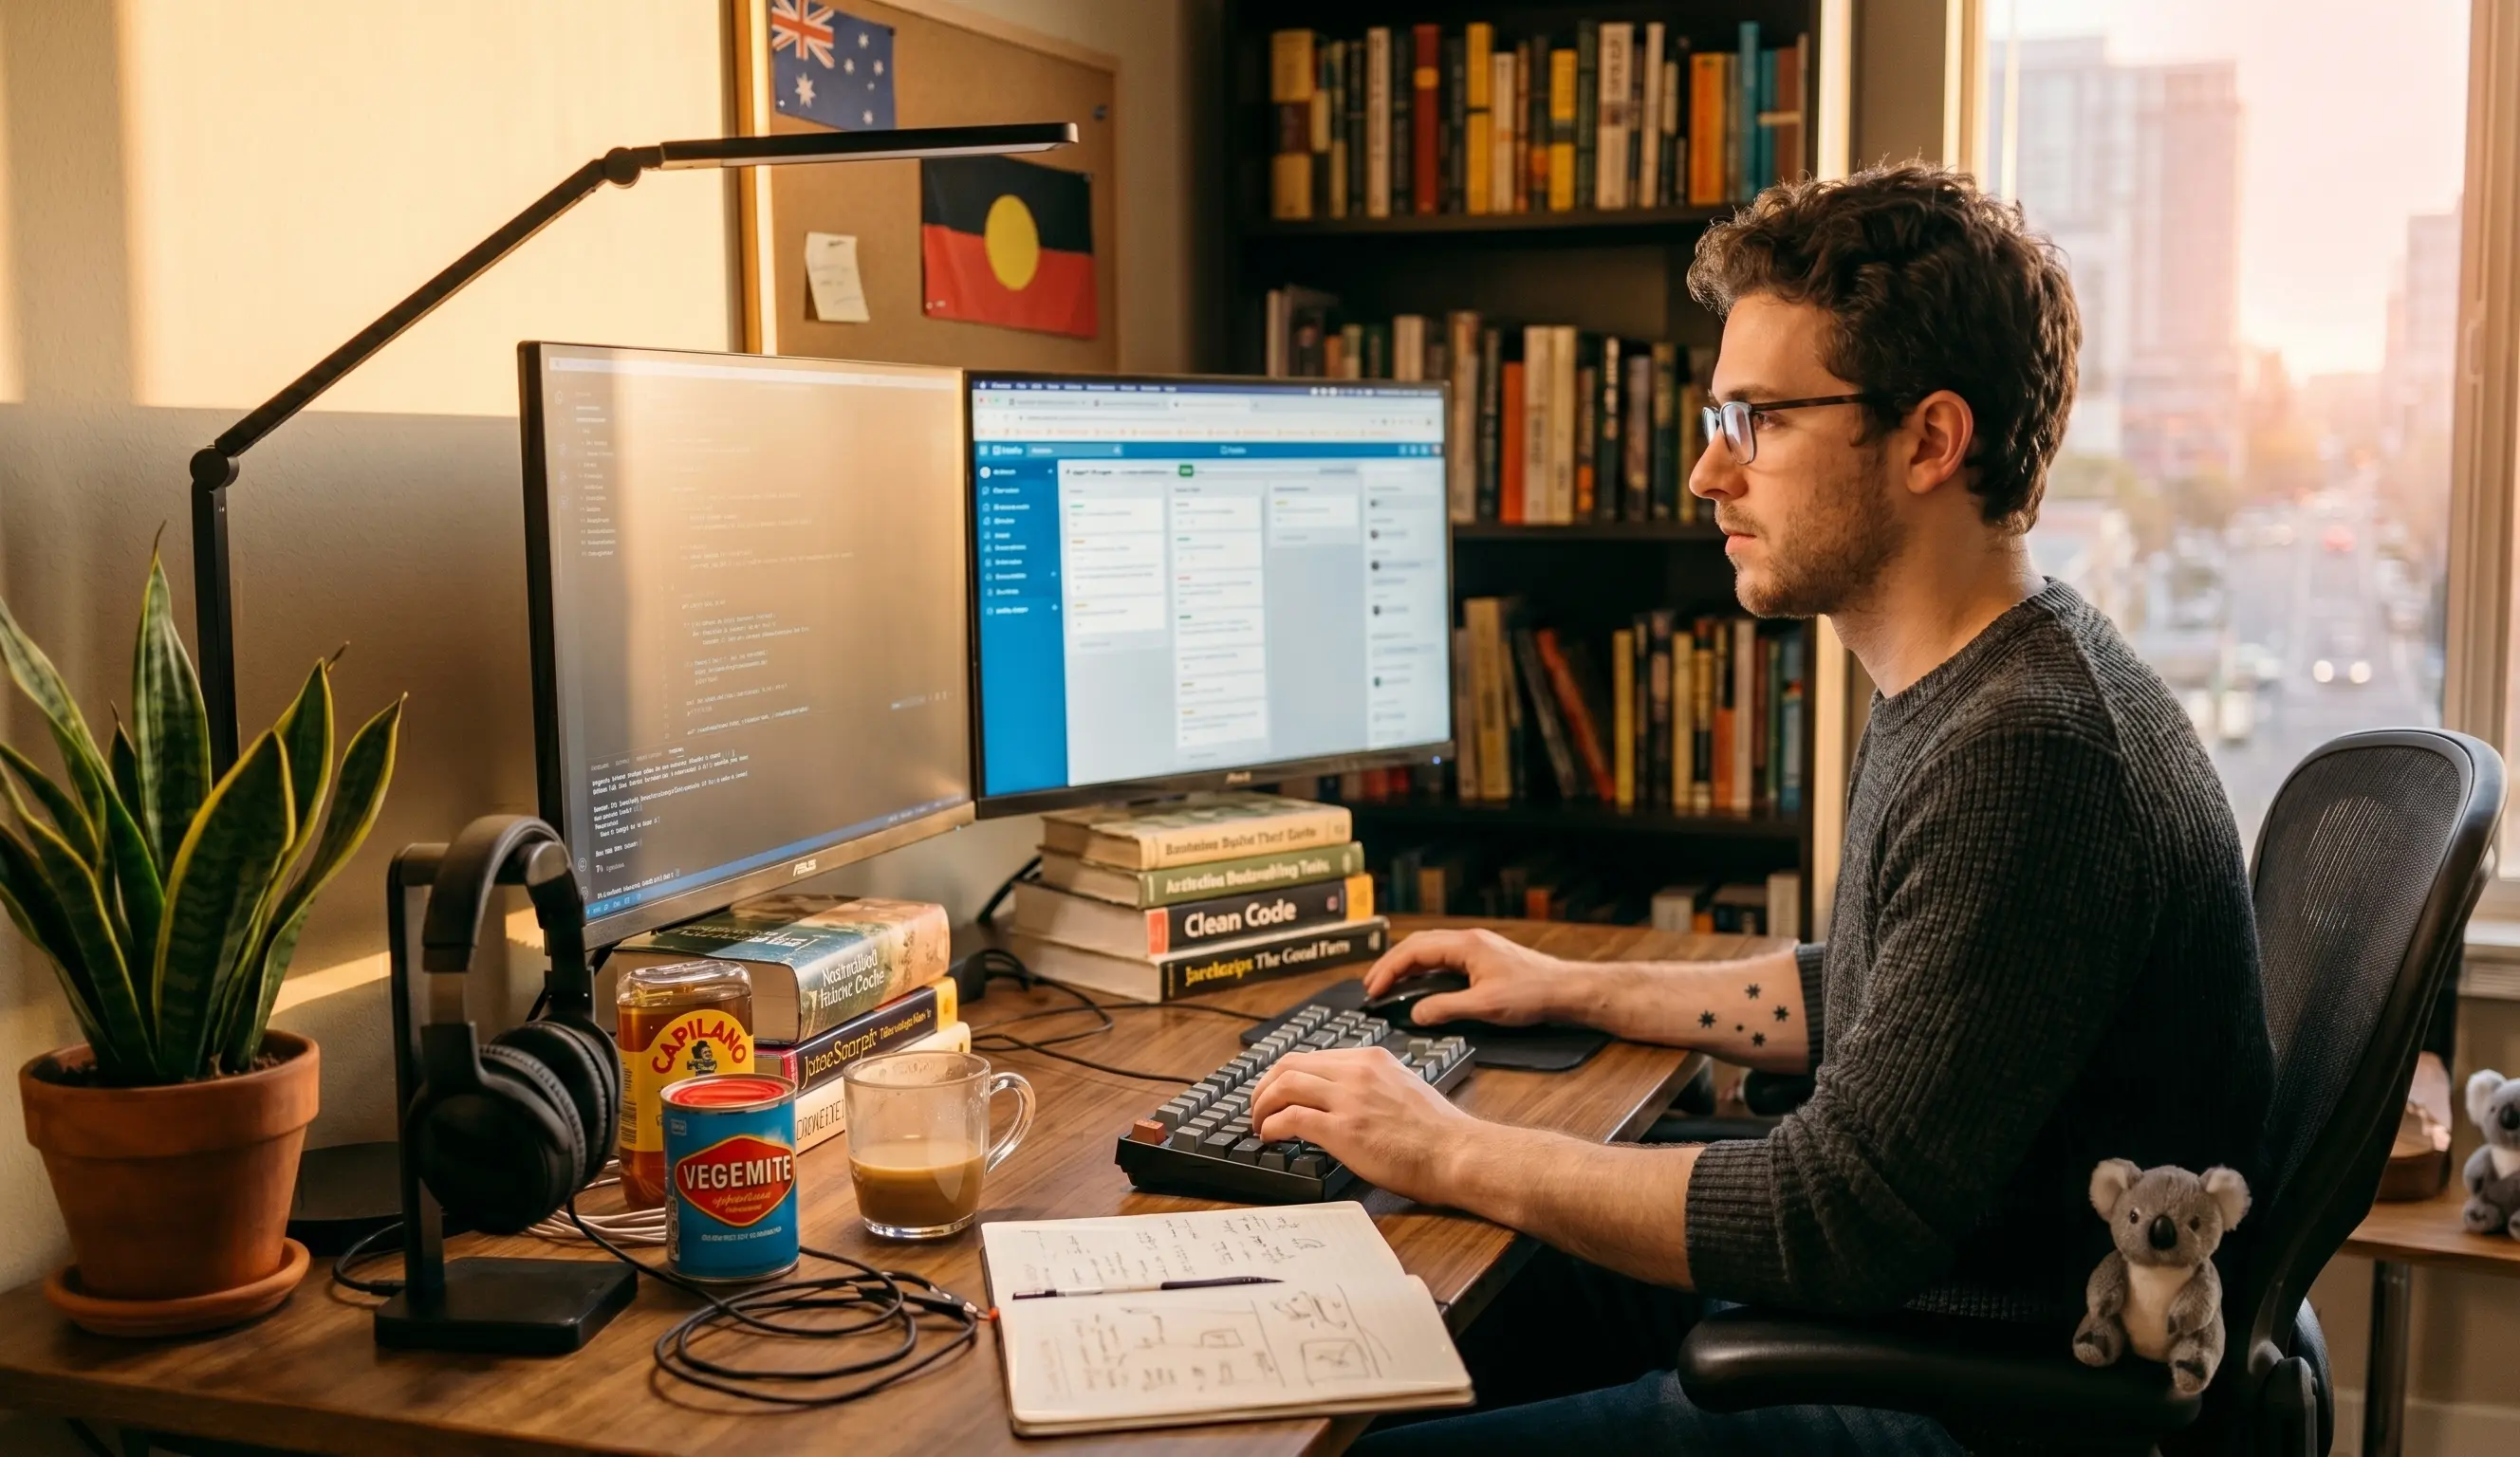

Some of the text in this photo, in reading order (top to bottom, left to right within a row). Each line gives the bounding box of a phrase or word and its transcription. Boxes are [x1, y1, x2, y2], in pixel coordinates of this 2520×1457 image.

[793, 859, 817, 876] ASUS
[1185, 899, 1297, 938] Clean Code
[652, 1018, 747, 1074] CAPILANO
[683, 1154, 792, 1190] VEGEMITE
